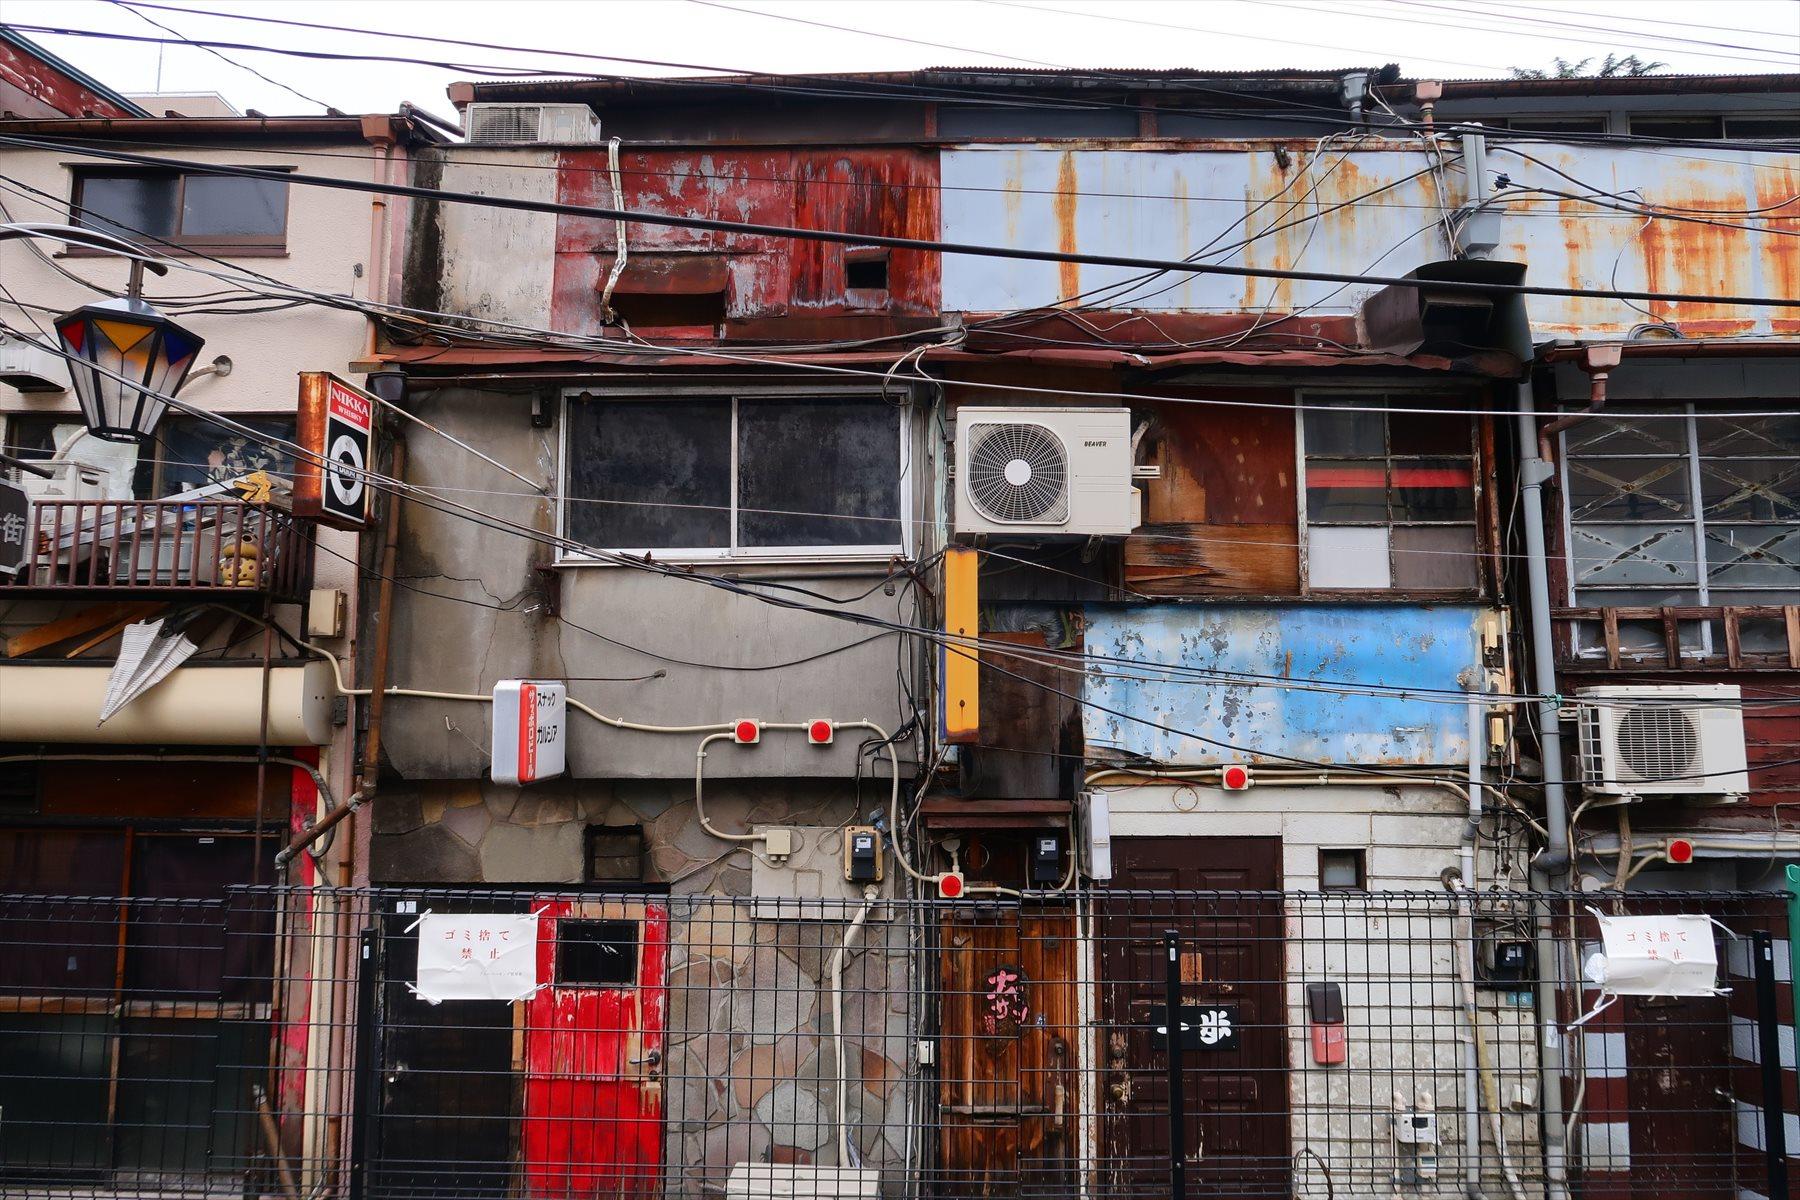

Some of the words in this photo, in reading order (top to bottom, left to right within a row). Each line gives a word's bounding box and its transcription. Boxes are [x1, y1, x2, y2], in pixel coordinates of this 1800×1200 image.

[332, 387, 369, 417] NIKKA
[338, 404, 363, 423] WHISKY
[1083, 440, 1107, 448] BEAVER
[0, 512, 25, 546] 街
[537, 691, 556, 707] スナック
[528, 689, 536, 779] サッポロビール
[536, 724, 558, 745] ガルシア
[444, 929, 510, 942] ゴミ捨て
[1626, 930, 1688, 943] ゴミ捨て
[461, 947, 502, 961] 禁止
[1647, 948, 1685, 961] 禁止
